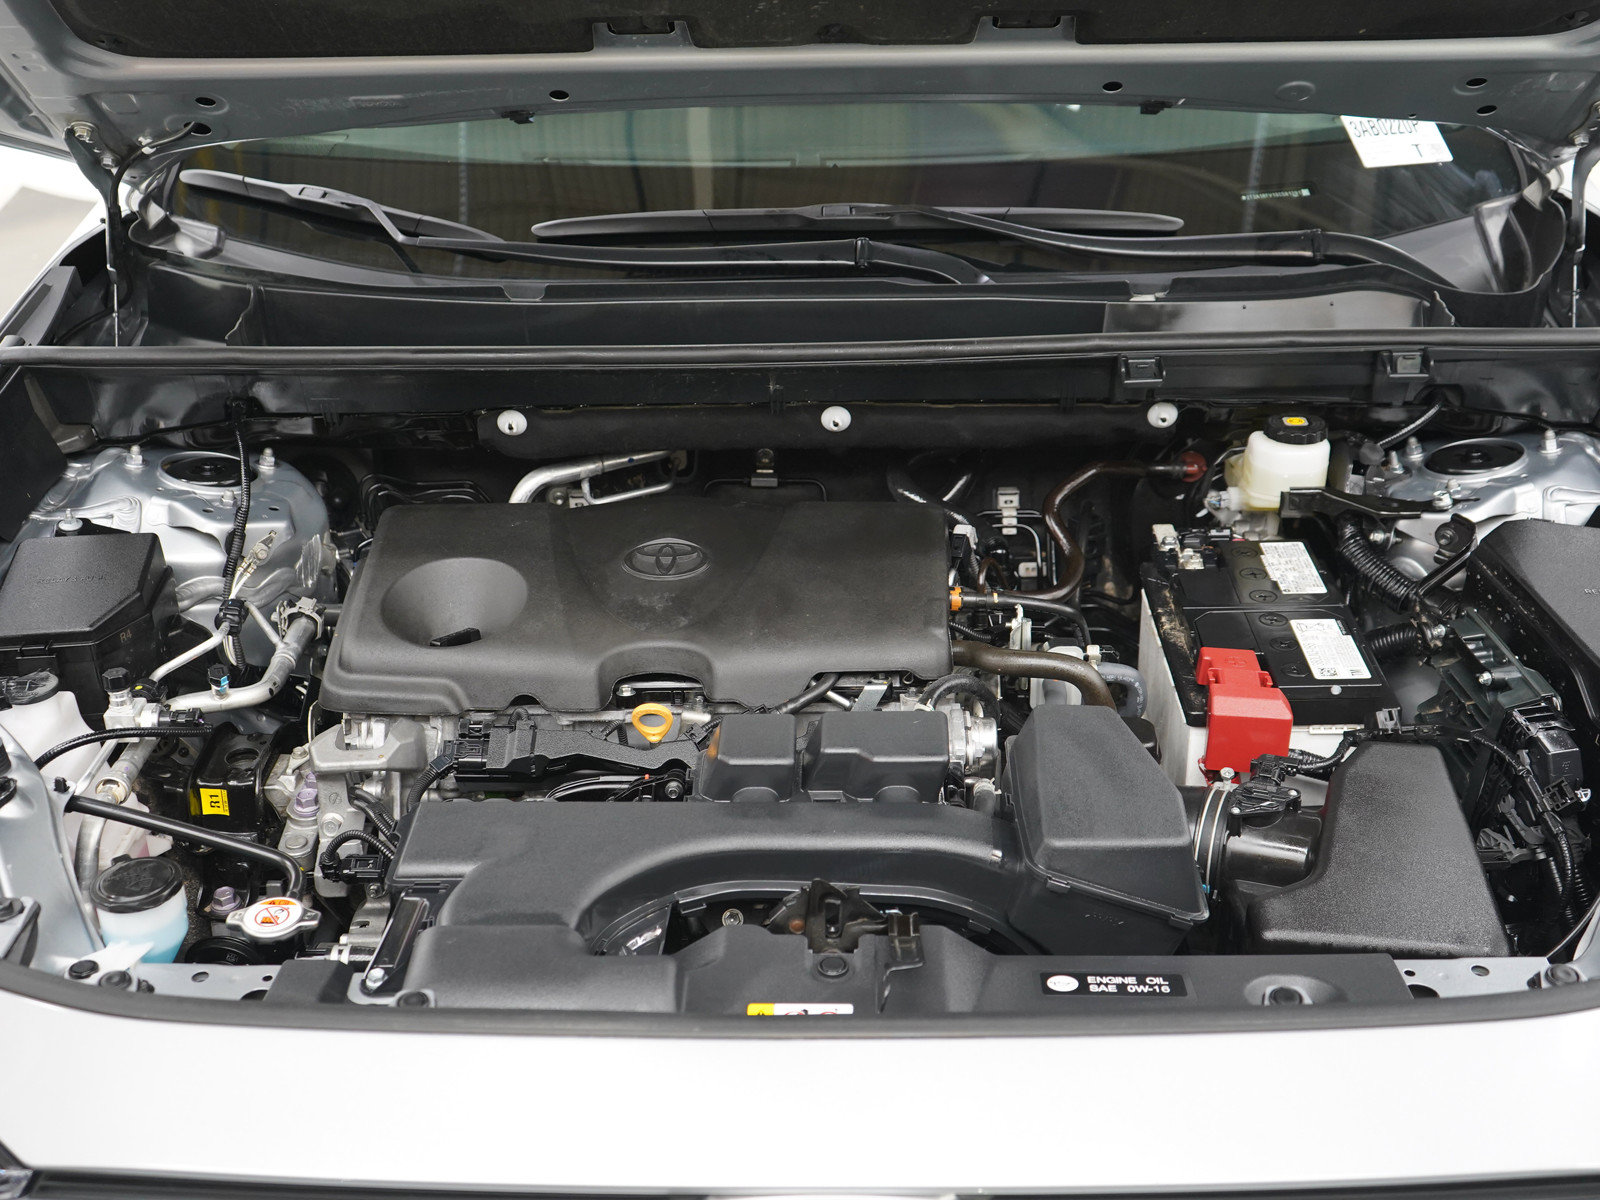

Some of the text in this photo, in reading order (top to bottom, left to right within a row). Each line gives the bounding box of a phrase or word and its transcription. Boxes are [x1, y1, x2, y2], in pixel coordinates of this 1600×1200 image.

[1411, 143, 1423, 158] T
[209, 794, 221, 809] R1
[1086, 975, 1169, 985] ENGINE OIL
[1089, 984, 1171, 993] SAE 0W-16
